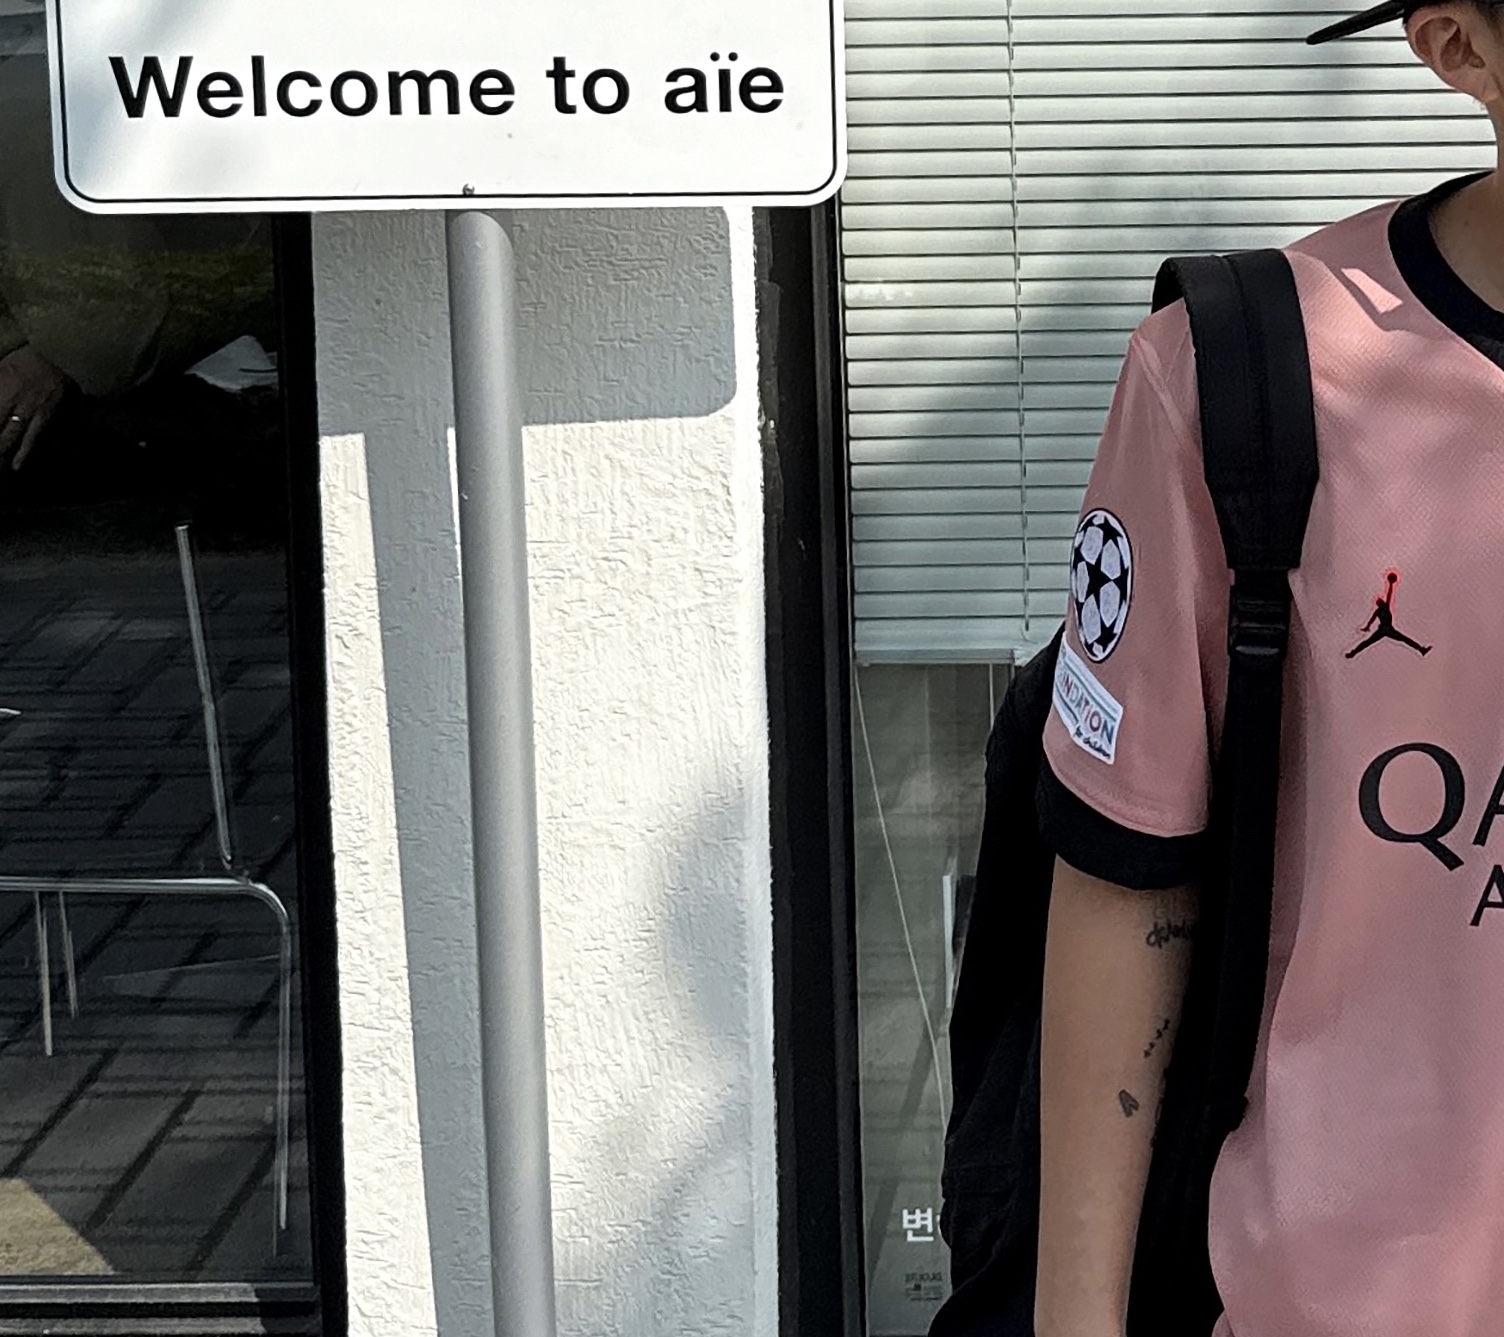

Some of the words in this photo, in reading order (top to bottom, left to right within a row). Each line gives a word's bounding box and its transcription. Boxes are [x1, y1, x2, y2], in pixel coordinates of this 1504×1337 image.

[109, 55, 515, 119] Welcome
[546, 56, 630, 115] to
[664, 52, 784, 114] aïe
[902, 1207, 941, 1242] 변
